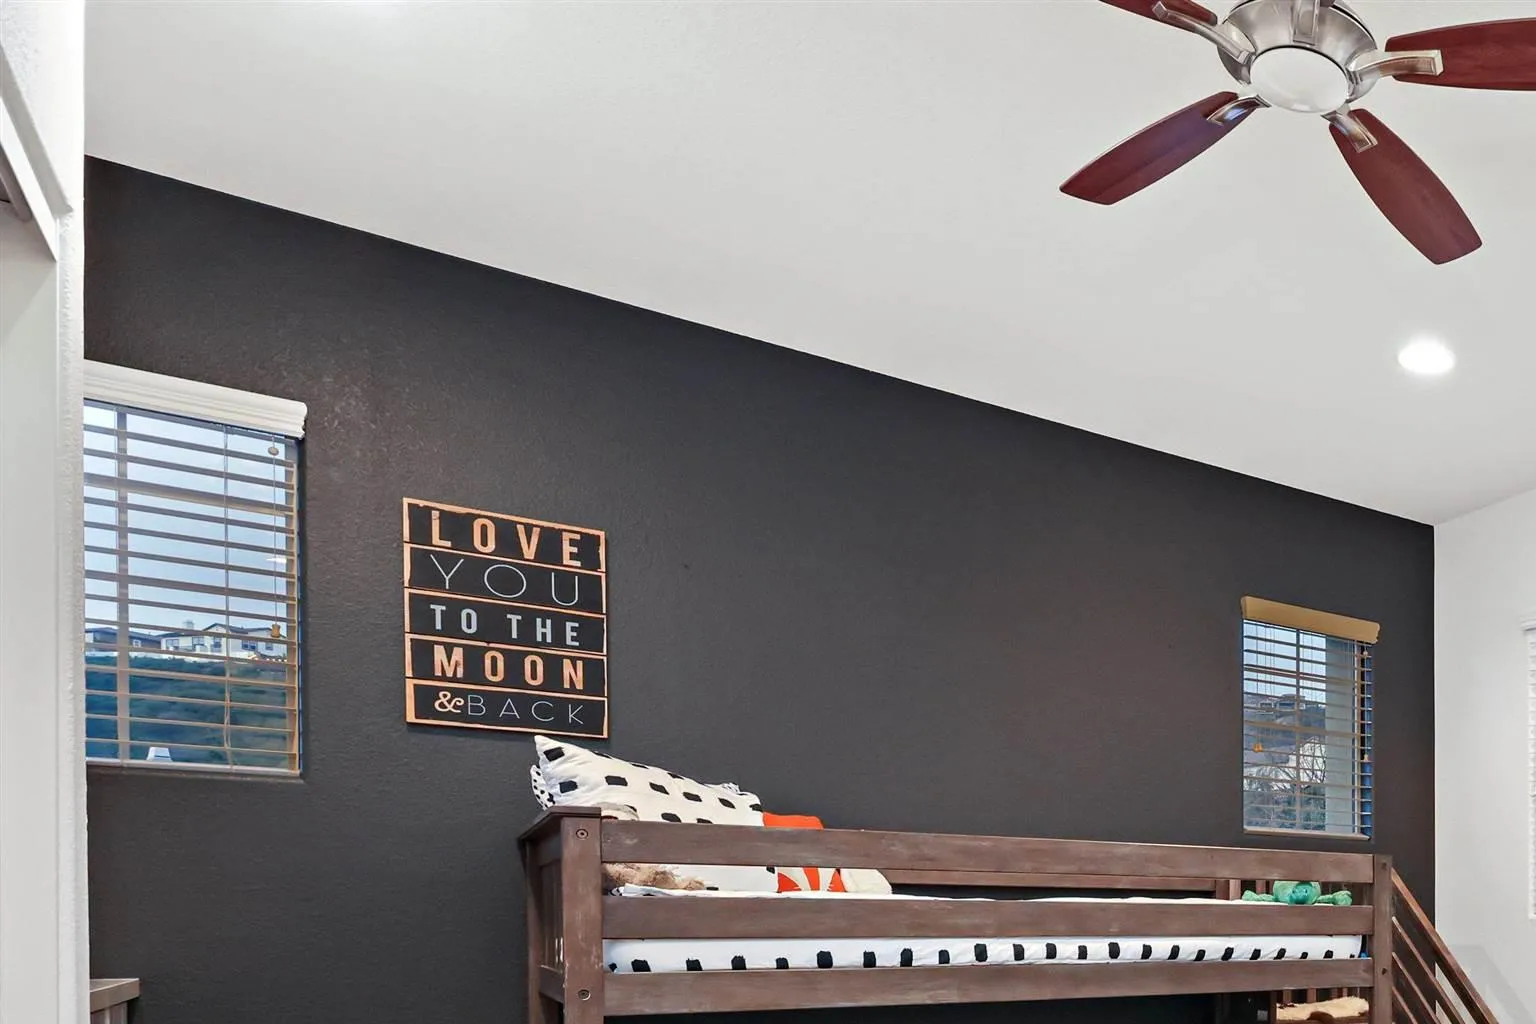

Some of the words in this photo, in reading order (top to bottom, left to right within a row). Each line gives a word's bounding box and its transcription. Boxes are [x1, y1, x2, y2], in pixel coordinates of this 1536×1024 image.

[431, 510, 582, 567] LOVE
[430, 553, 579, 606] YOU
[430, 603, 478, 634] TO
[506, 613, 580, 646] THE
[433, 644, 584, 690] MOON
